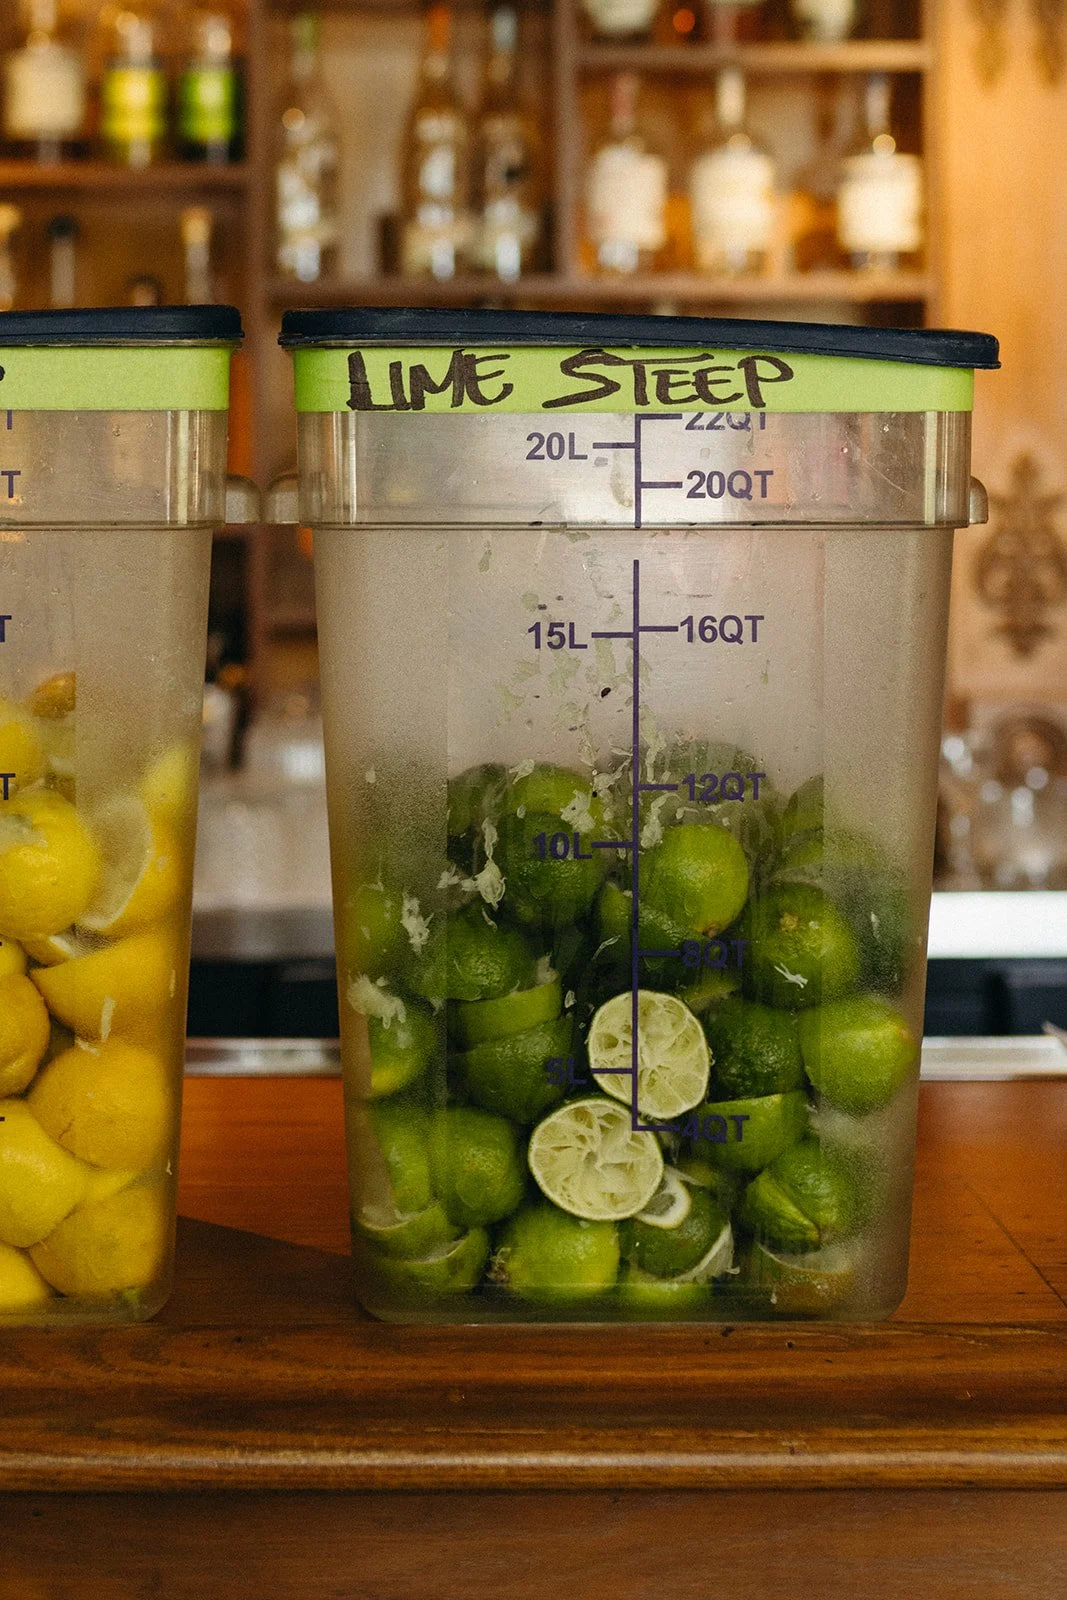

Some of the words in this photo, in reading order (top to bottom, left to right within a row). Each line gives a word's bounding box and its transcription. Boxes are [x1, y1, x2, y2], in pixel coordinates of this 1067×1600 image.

[346, 349, 514, 411] LIME
[541, 348, 794, 409] STEEP
[684, 412, 767, 432] 22QT
[525, 432, 589, 461] 20L
[686, 470, 774, 500] 20QT
[527, 621, 588, 650] 15L
[680, 614, 765, 645] 16QT
[682, 772, 766, 803] 12QT
[532, 831, 593, 860] 10L
[681, 939, 749, 969] 8QT
[546, 1056, 588, 1086] 5L
[680, 1114, 750, 1143] 4QT
